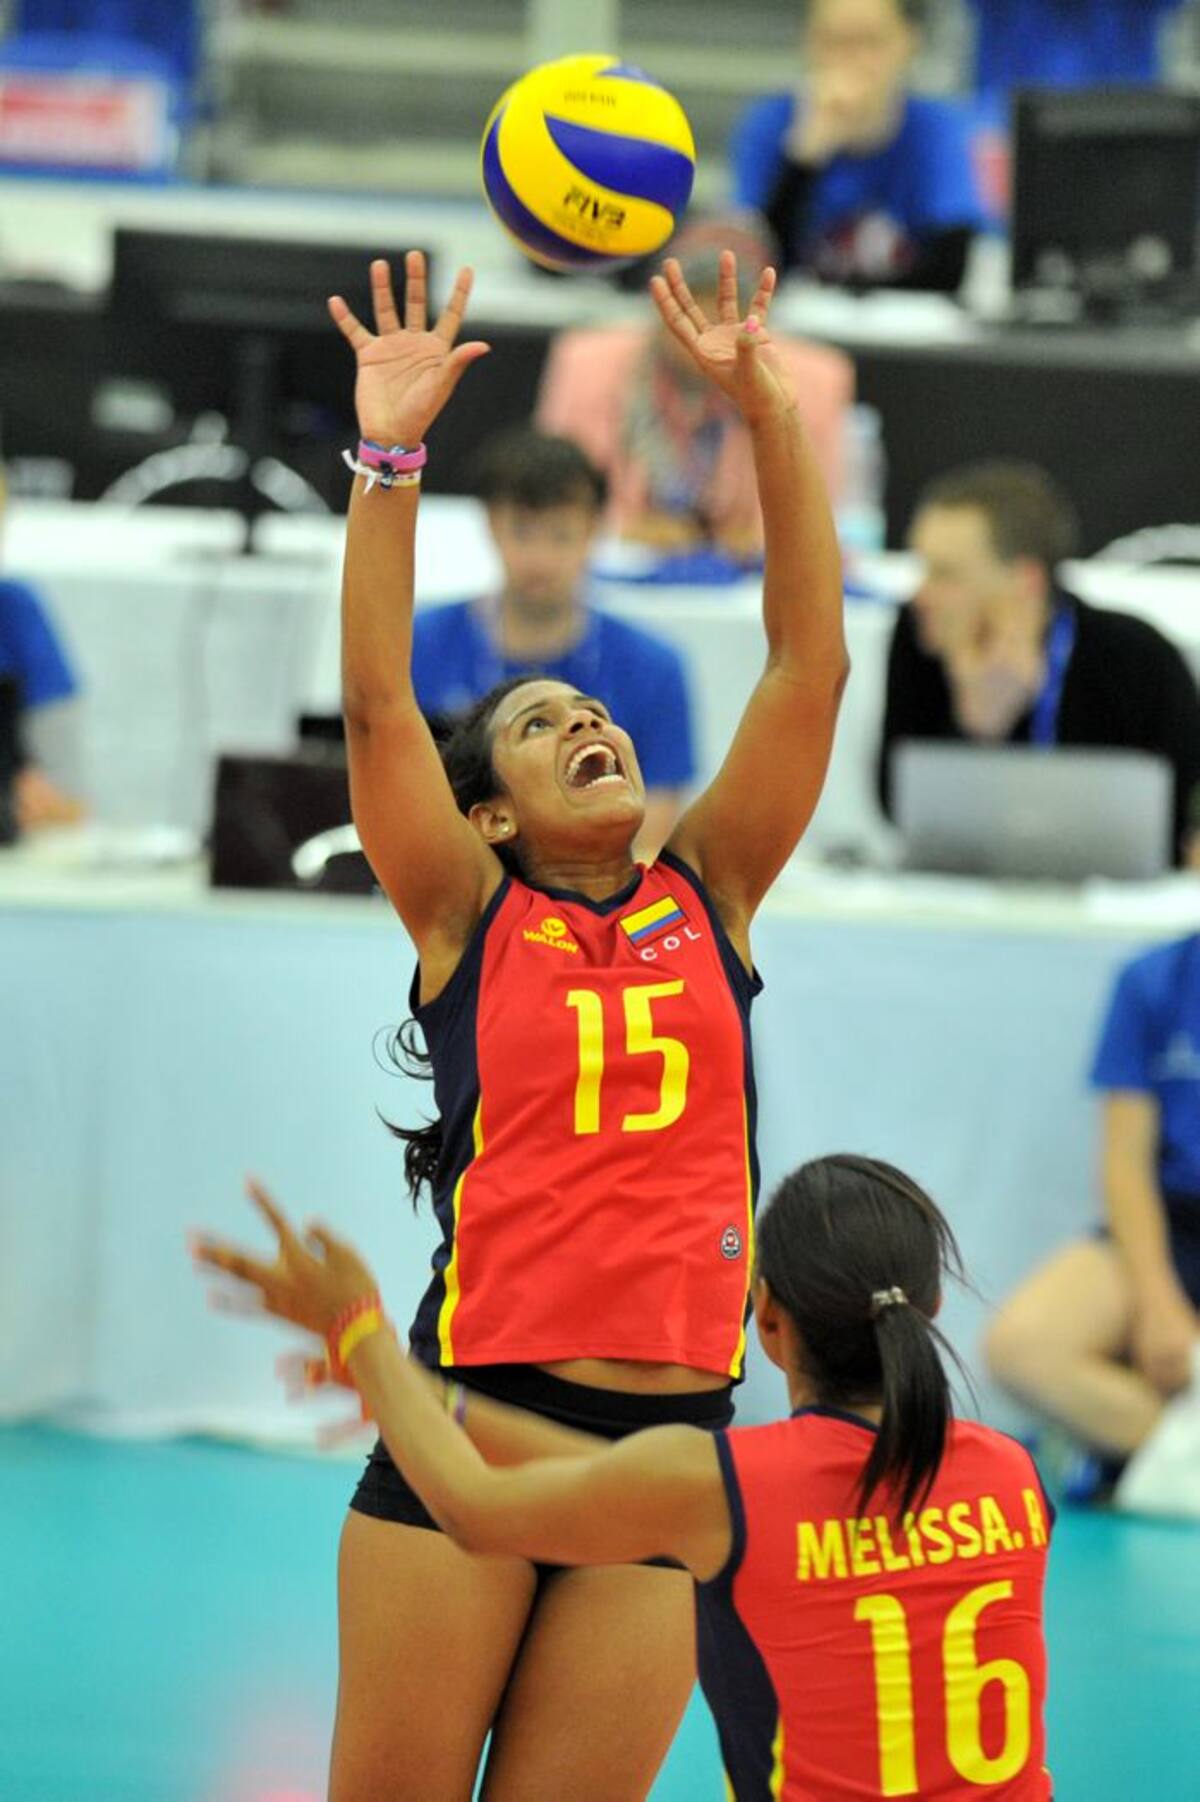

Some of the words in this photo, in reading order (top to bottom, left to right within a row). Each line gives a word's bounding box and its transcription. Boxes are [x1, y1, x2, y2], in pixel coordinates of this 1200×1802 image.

[640, 926, 701, 961] COL
[565, 978, 690, 1135] 15
[853, 1579, 1032, 1797] 16
